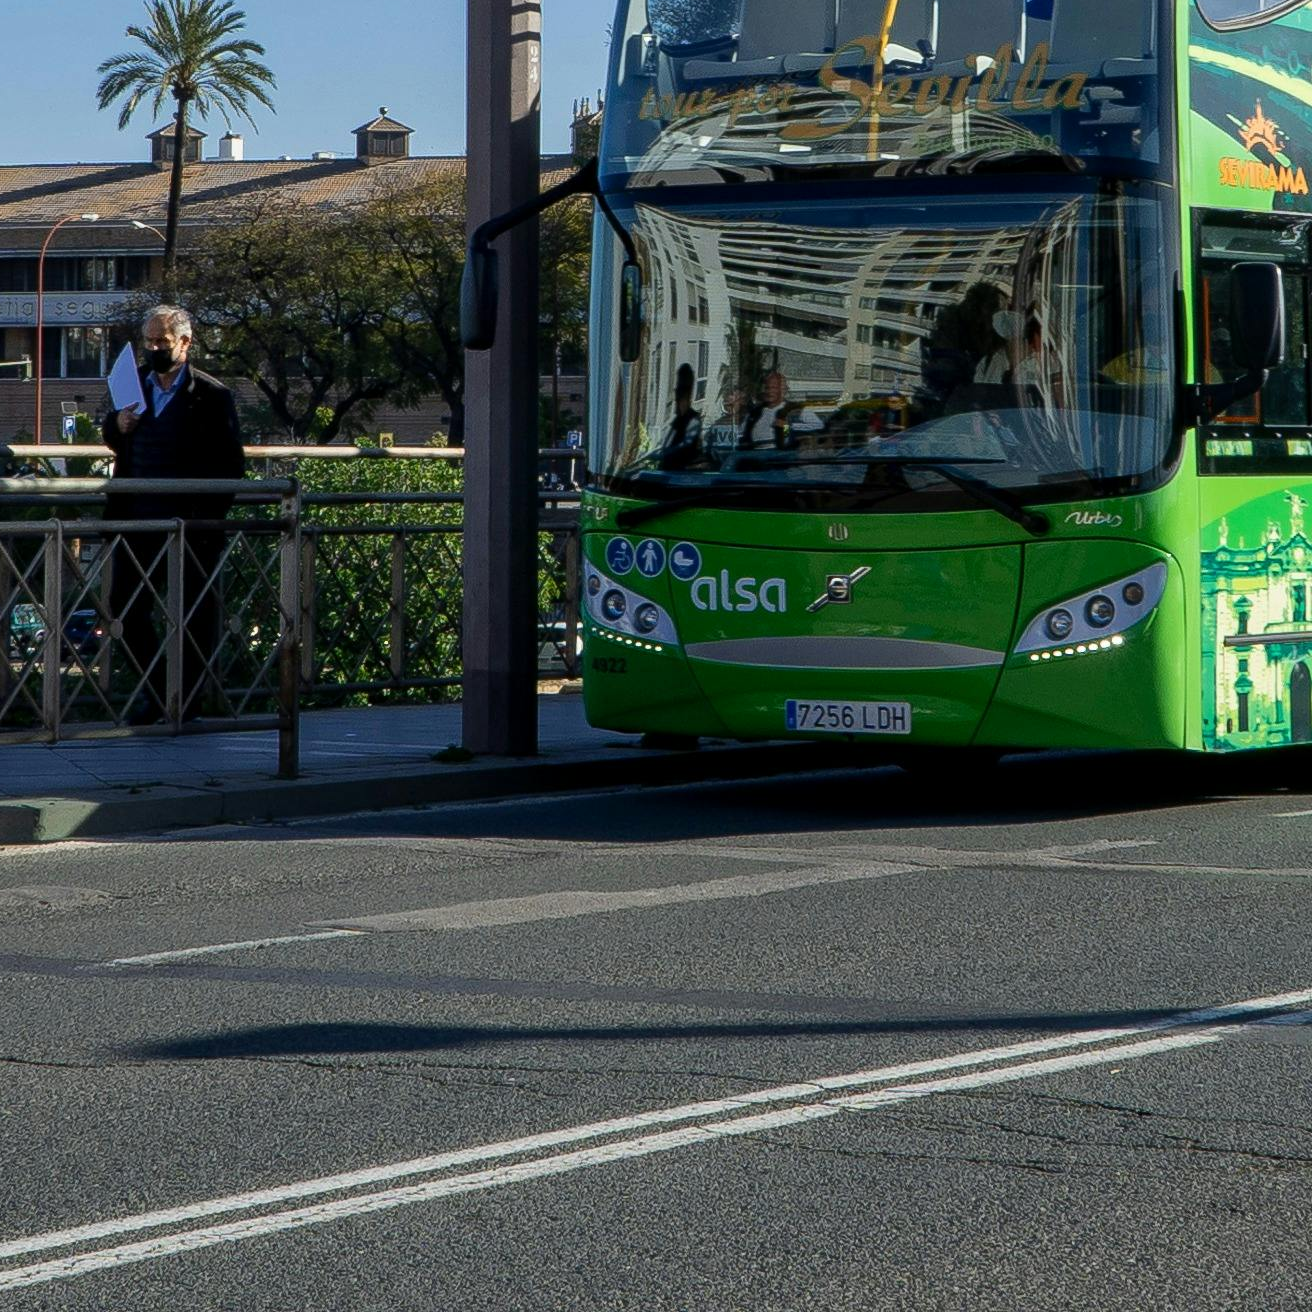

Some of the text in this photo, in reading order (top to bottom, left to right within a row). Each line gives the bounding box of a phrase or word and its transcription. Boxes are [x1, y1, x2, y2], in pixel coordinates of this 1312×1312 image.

[779, 35, 1088, 141] Sevilla
[691, 569, 786, 612] alsa
[798, 704, 906, 730] 7256 LDH
